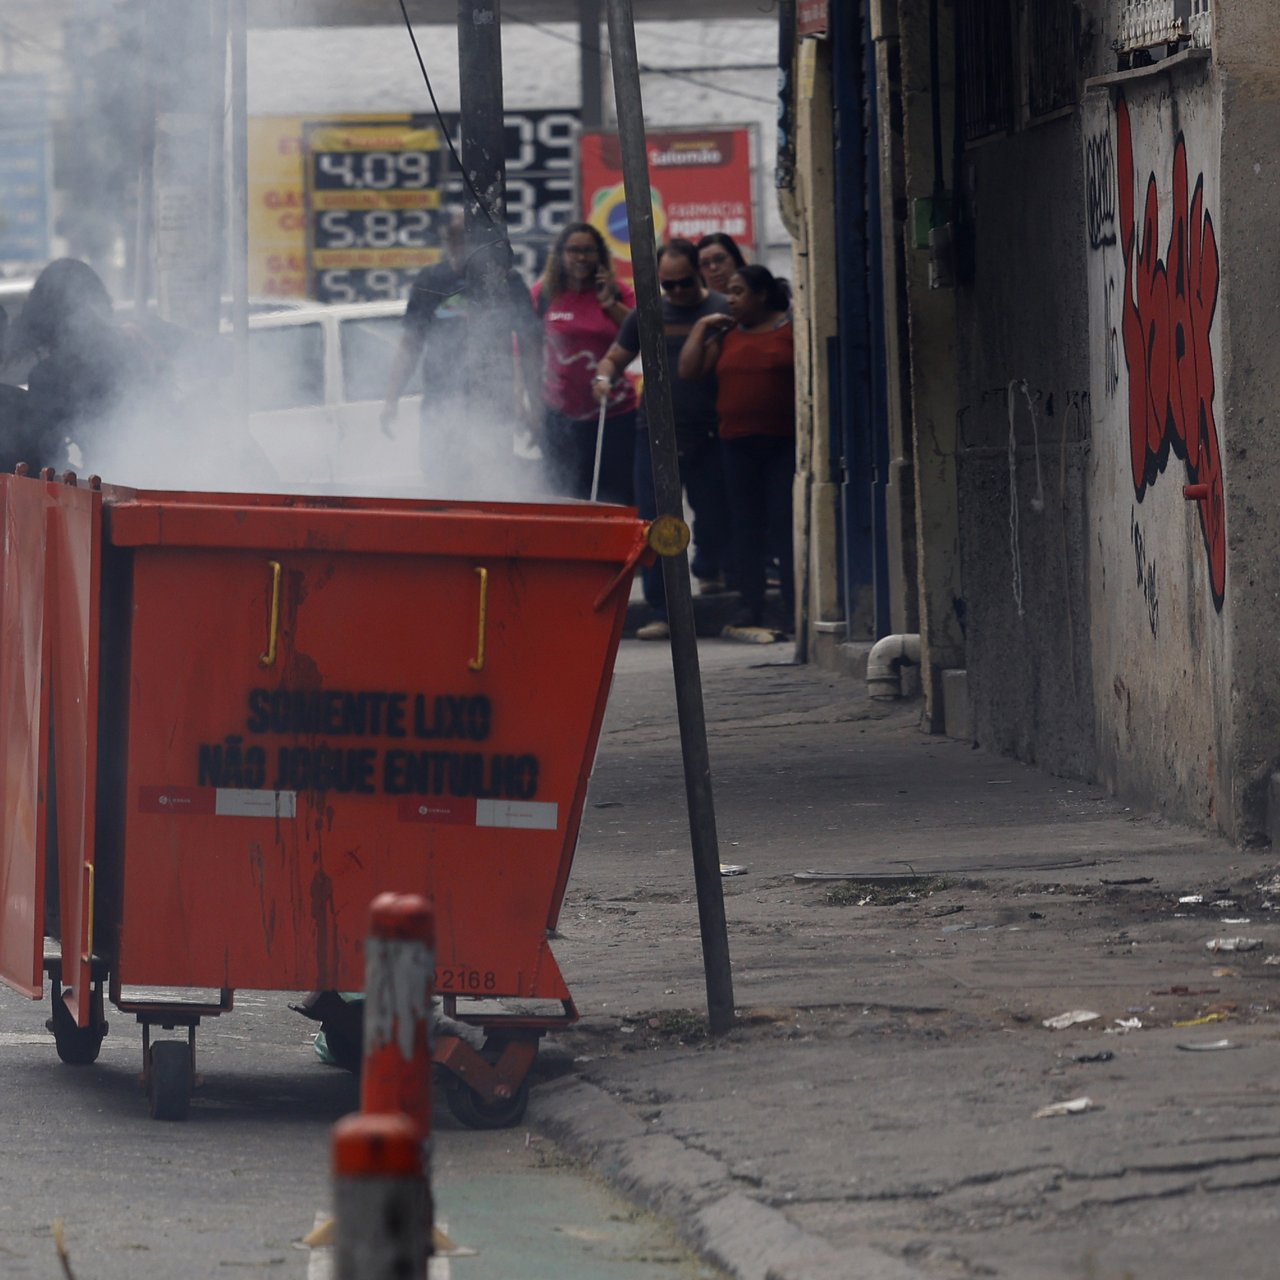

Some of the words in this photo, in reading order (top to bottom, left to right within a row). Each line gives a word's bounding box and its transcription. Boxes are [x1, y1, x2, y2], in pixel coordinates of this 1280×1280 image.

[319, 152, 431, 189] 4.09
[320, 210, 432, 249] 5.82
[669, 218, 746, 236] POPULAR
[247, 687, 407, 739] SOMENTE
[413, 692, 493, 742] LIXO
[198, 735, 266, 790] NÃO
[382, 748, 540, 800] ENTULHO
